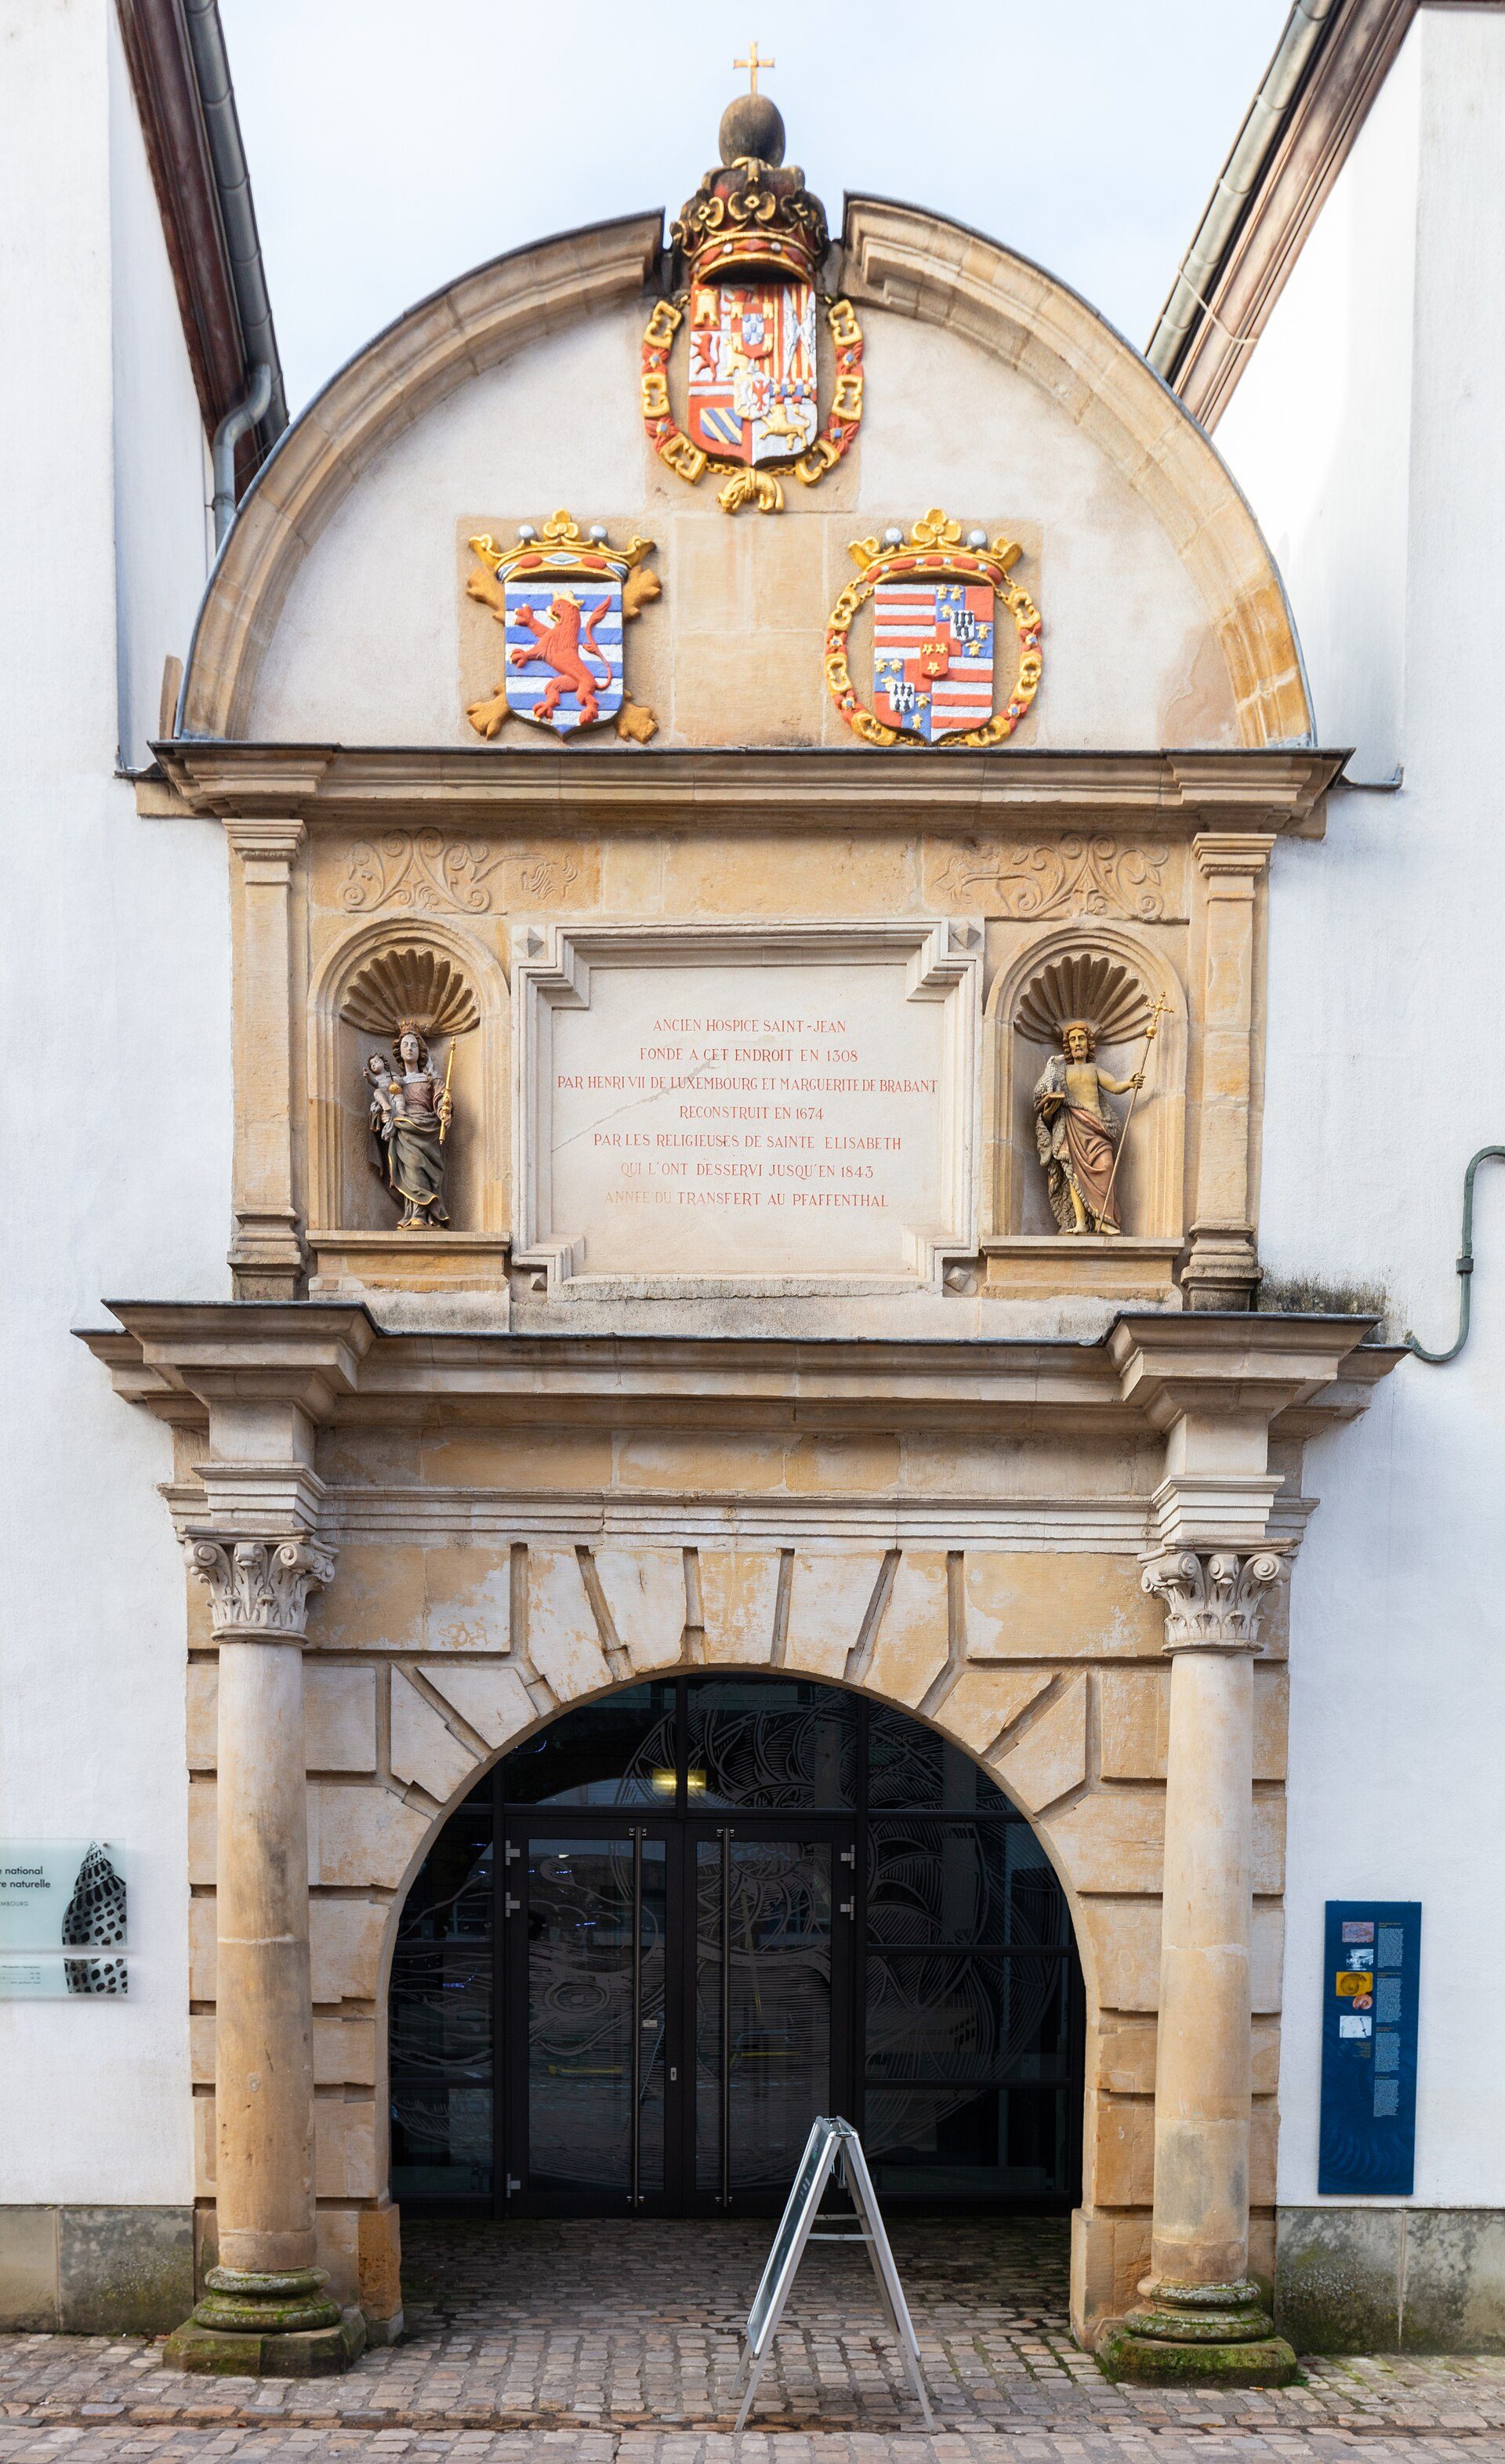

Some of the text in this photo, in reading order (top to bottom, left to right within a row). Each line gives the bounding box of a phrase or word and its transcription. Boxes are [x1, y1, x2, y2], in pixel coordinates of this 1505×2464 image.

[653, 1018, 846, 1033] ANCIEN HOSPICE SAINT-JEAN
[640, 1047, 858, 1062] FONDE A CET ENDROIT EN 1308
[557, 1076, 938, 1094] PAR HENRI VII DE LUXEMBOURG ET MARGUERITE DE BRABANT
[680, 1105, 824, 1119] RECONSTRUIT EN 1674
[594, 1134, 901, 1149] PAR LES RELIGIEUSES DE SAINTE ELISABETH
[621, 1162, 641, 1176] QUI
[697, 1163, 763, 1177] DESSERVI
[769, 1163, 835, 1179] JUSQU'EN
[841, 1165, 874, 1178] 1843
[604, 1191, 889, 1207] ANNEE DU TRANSFERT AU PFAFFENTHAL
[5, 1865, 43, 1874] national
[9, 1878, 51, 1888] naturelle
